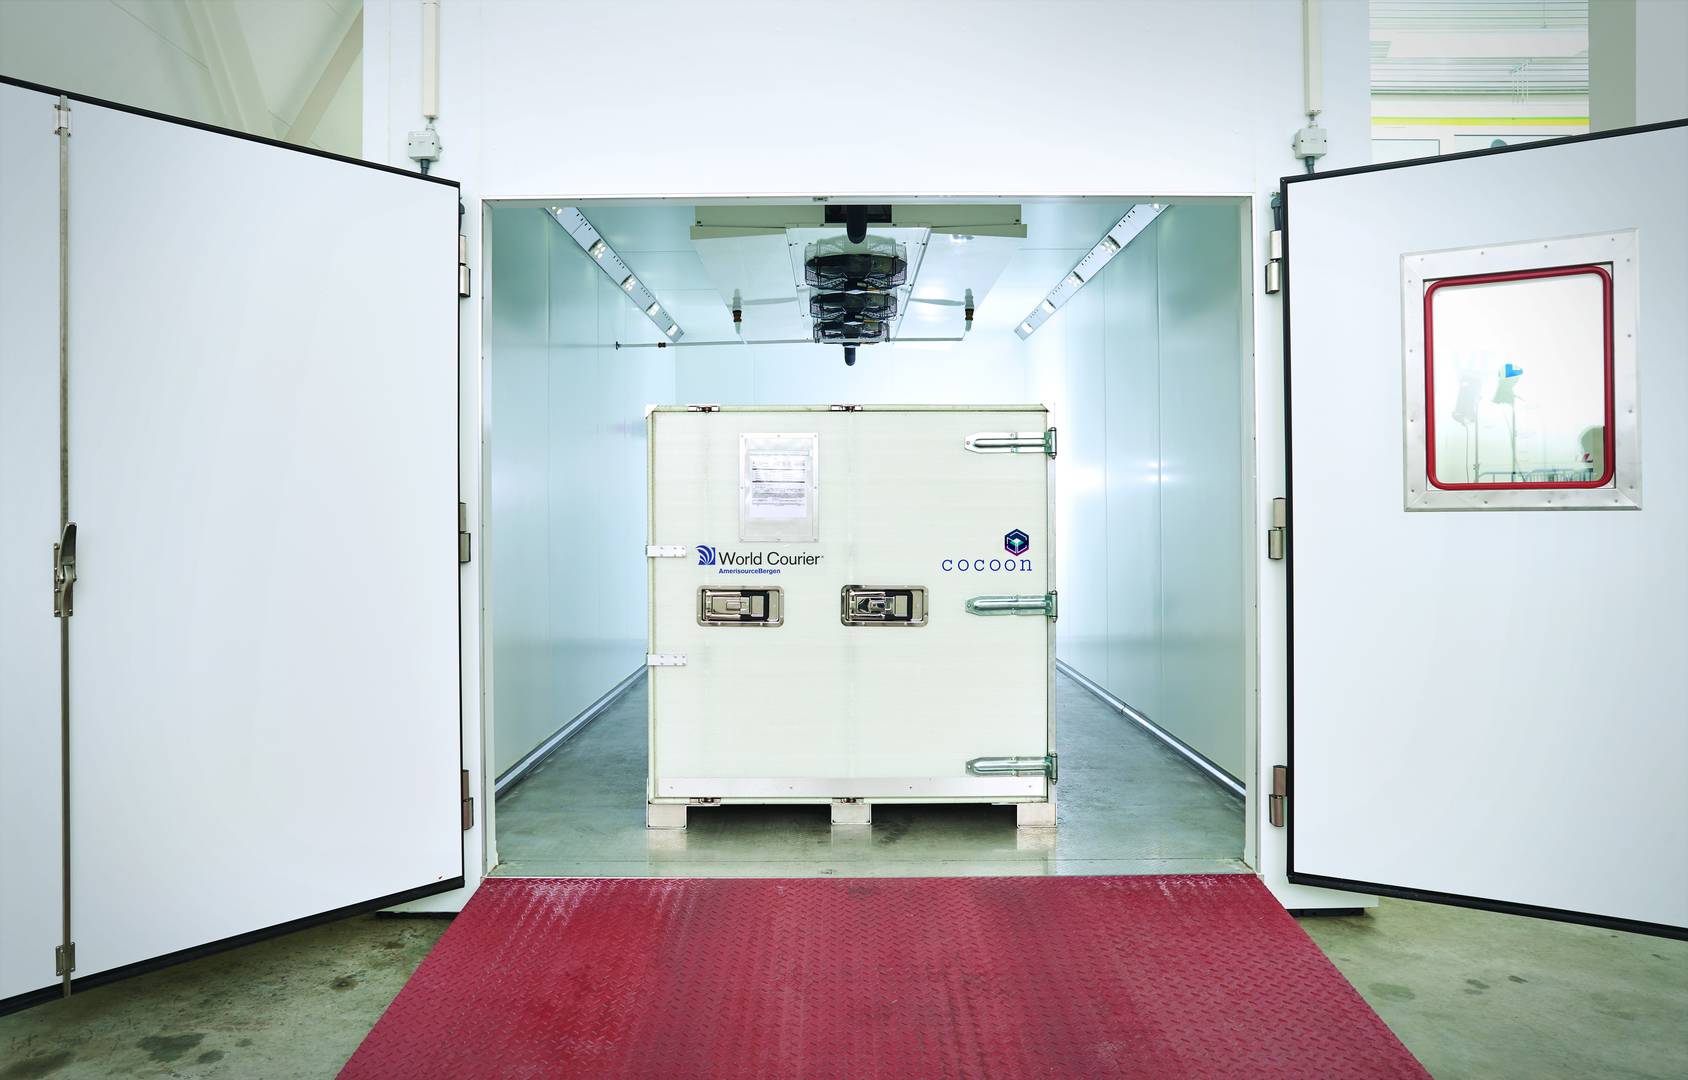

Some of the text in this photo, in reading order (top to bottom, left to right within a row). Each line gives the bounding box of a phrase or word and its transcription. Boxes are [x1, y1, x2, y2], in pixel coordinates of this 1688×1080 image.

[719, 551, 820, 566] World Courier
[719, 568, 781, 576] AmerisourceBergen
[942, 559, 1032, 572] cocoon
